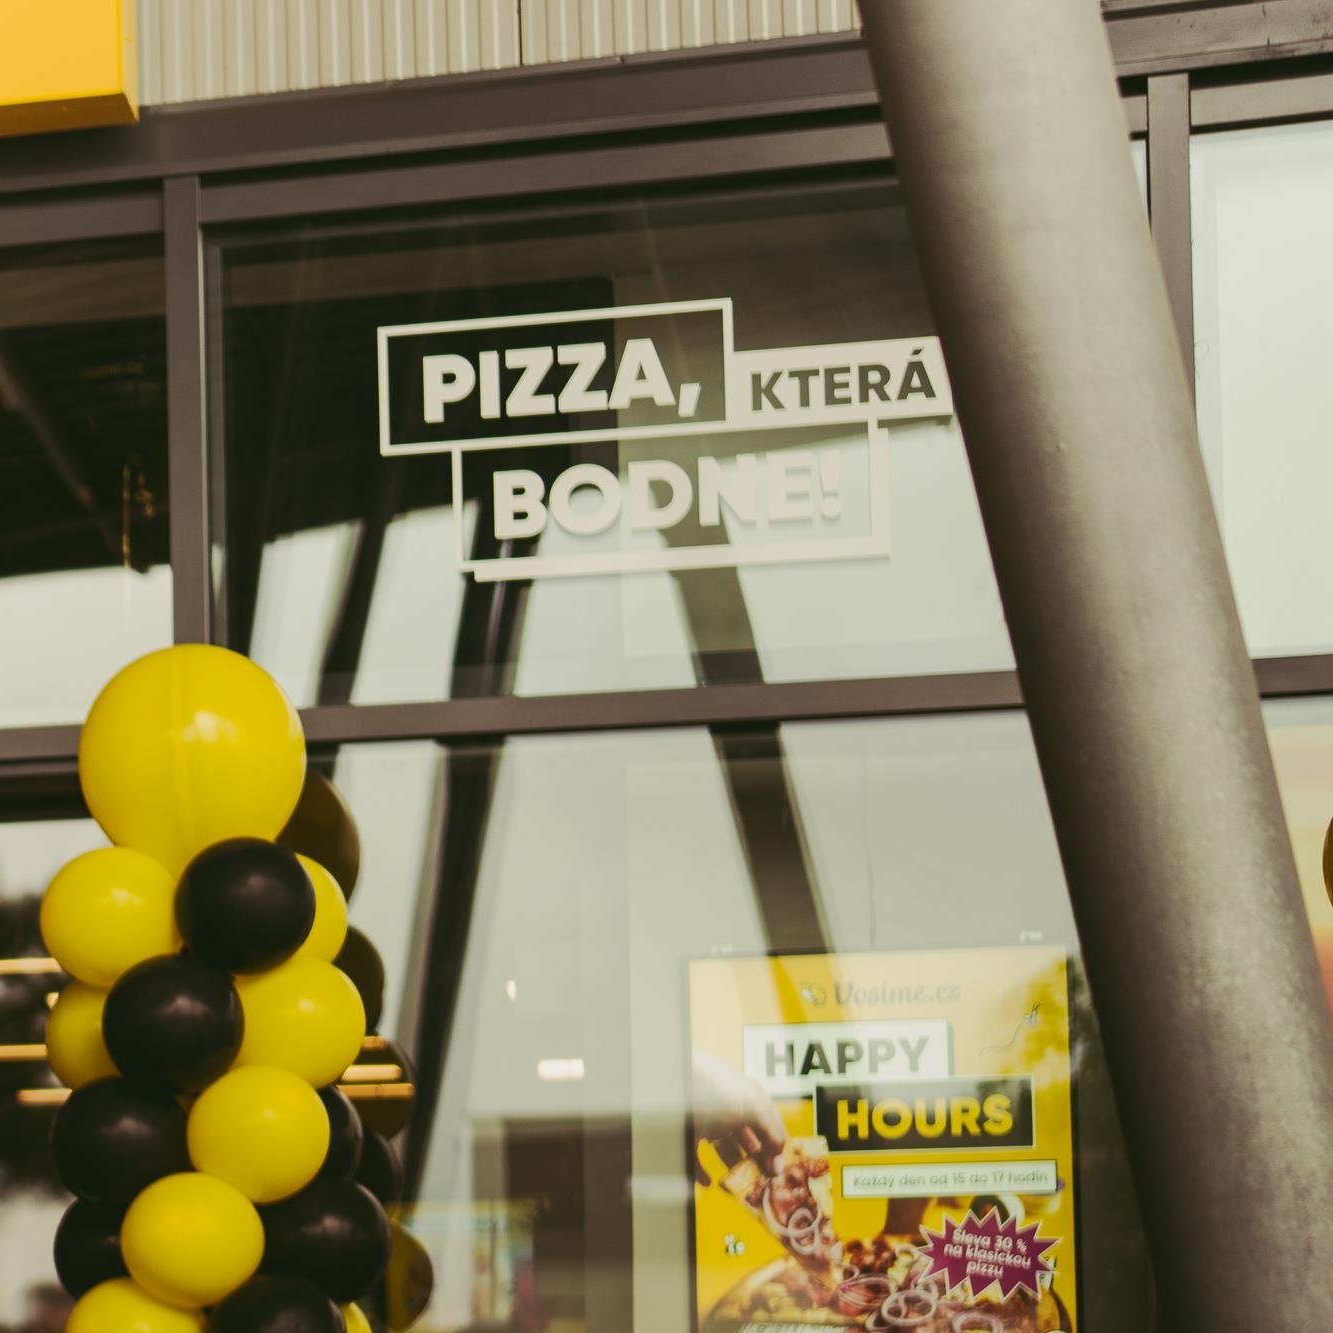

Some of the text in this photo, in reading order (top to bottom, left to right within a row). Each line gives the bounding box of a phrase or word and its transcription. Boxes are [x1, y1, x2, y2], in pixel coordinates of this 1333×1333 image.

[422, 336, 937, 423] PIZZA, KTERÁ
[492, 451, 843, 540] BODNE!
[765, 1036, 930, 1077] HAPPY
[837, 1094, 1014, 1140] HOURS
[929, 1173, 948, 1185] od
[969, 1172, 988, 1184] do
[1007, 1170, 1047, 1183] hodin
[953, 1227, 991, 1248] Sleva
[995, 1235, 1013, 1251] 30
[944, 1243, 1032, 1270] na klasickou
[966, 1259, 1004, 1278] pizzu
